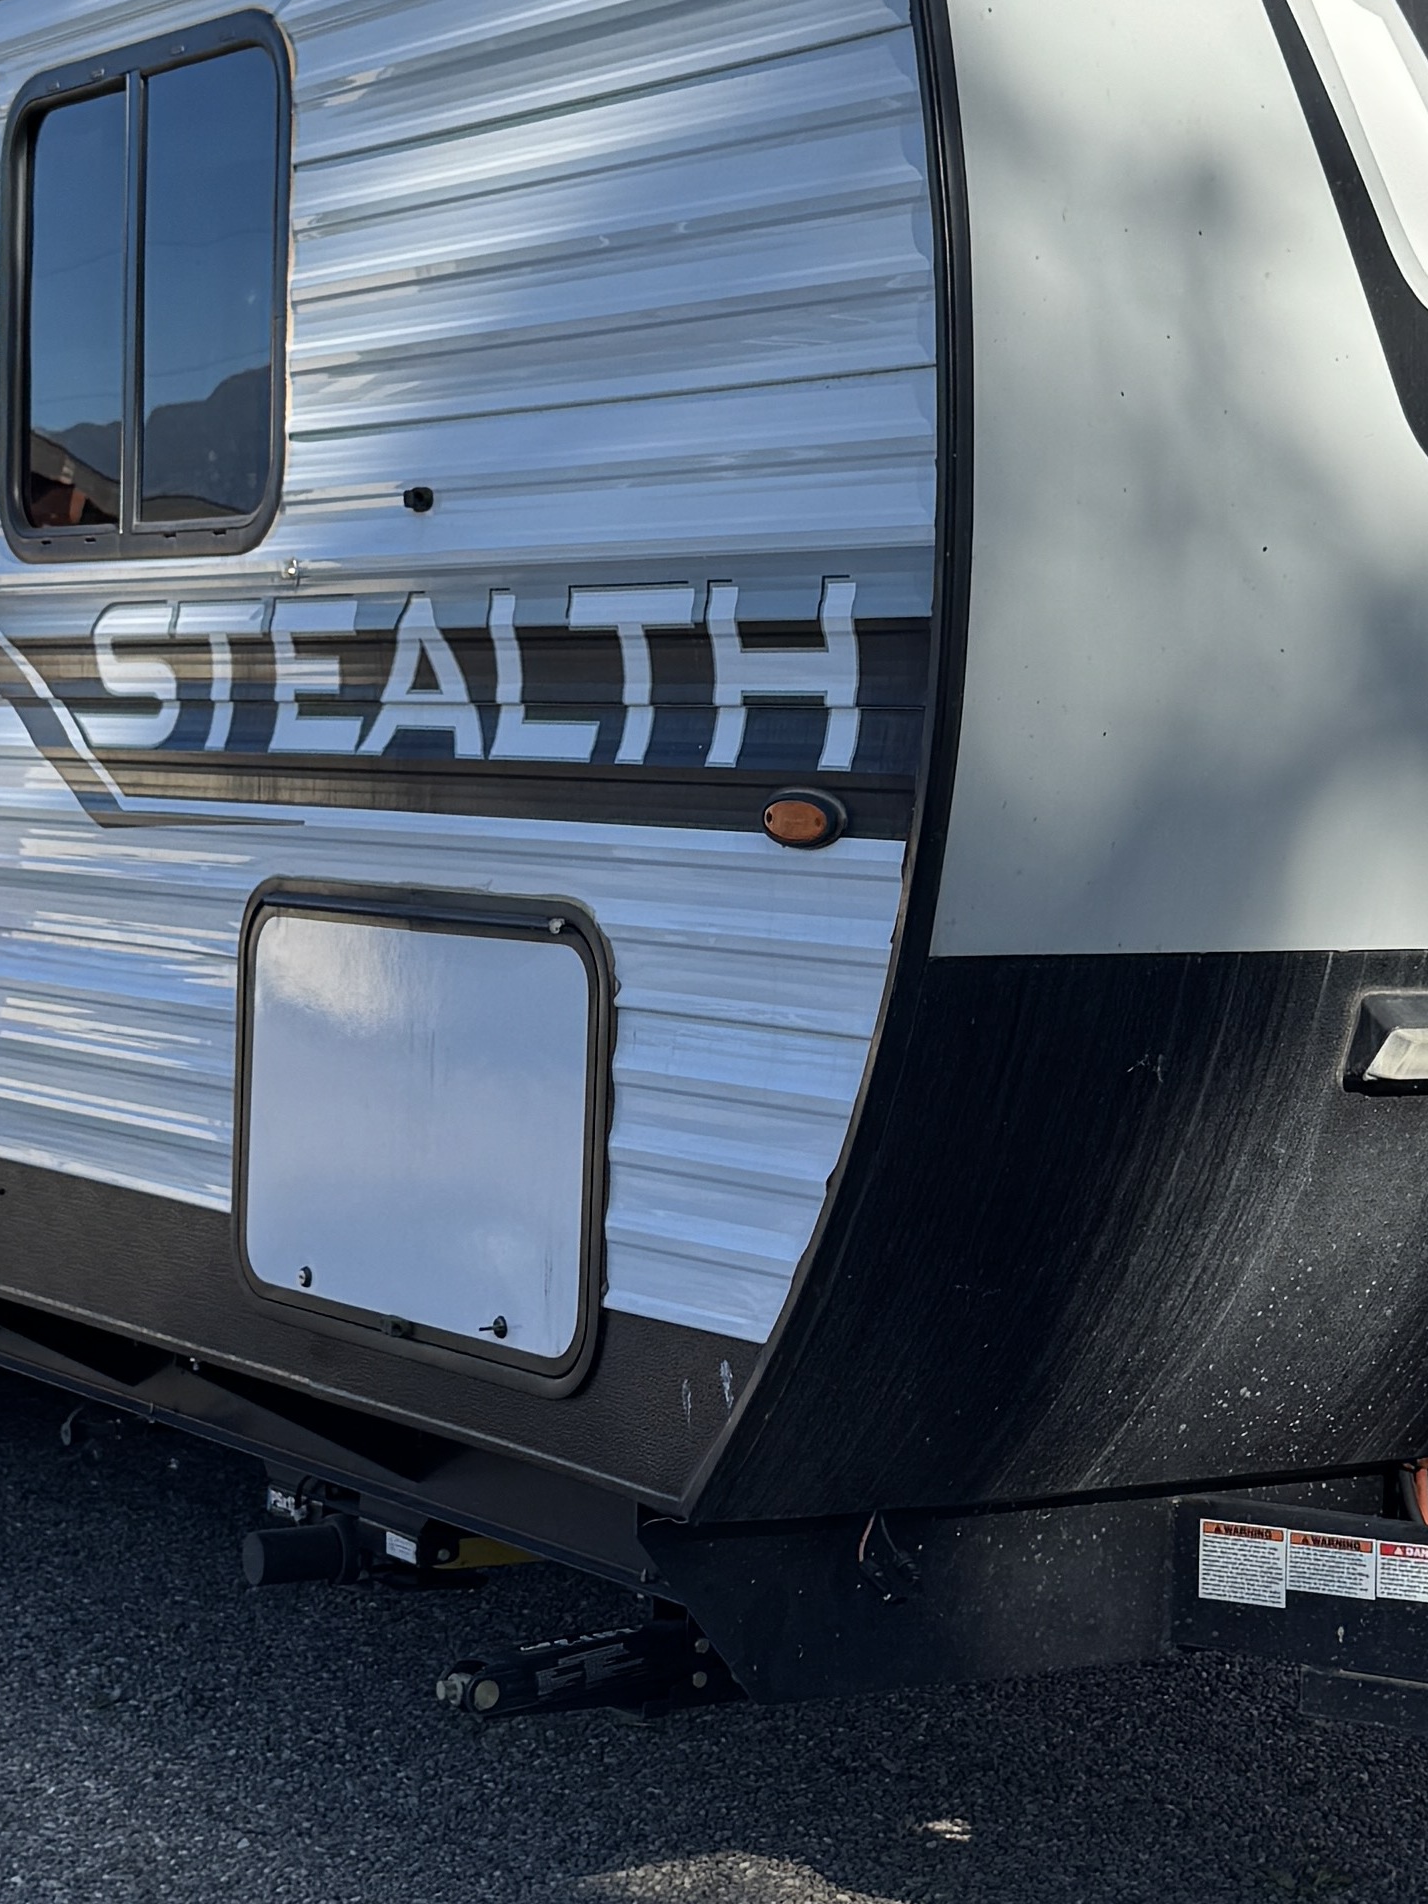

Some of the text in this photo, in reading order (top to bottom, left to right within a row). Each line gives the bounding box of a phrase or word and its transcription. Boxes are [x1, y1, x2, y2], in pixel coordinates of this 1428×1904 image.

[73, 575, 860, 772] STEALTH
[1223, 1524, 1272, 1540] WARNING
[1310, 1535, 1361, 1551] WARNING
